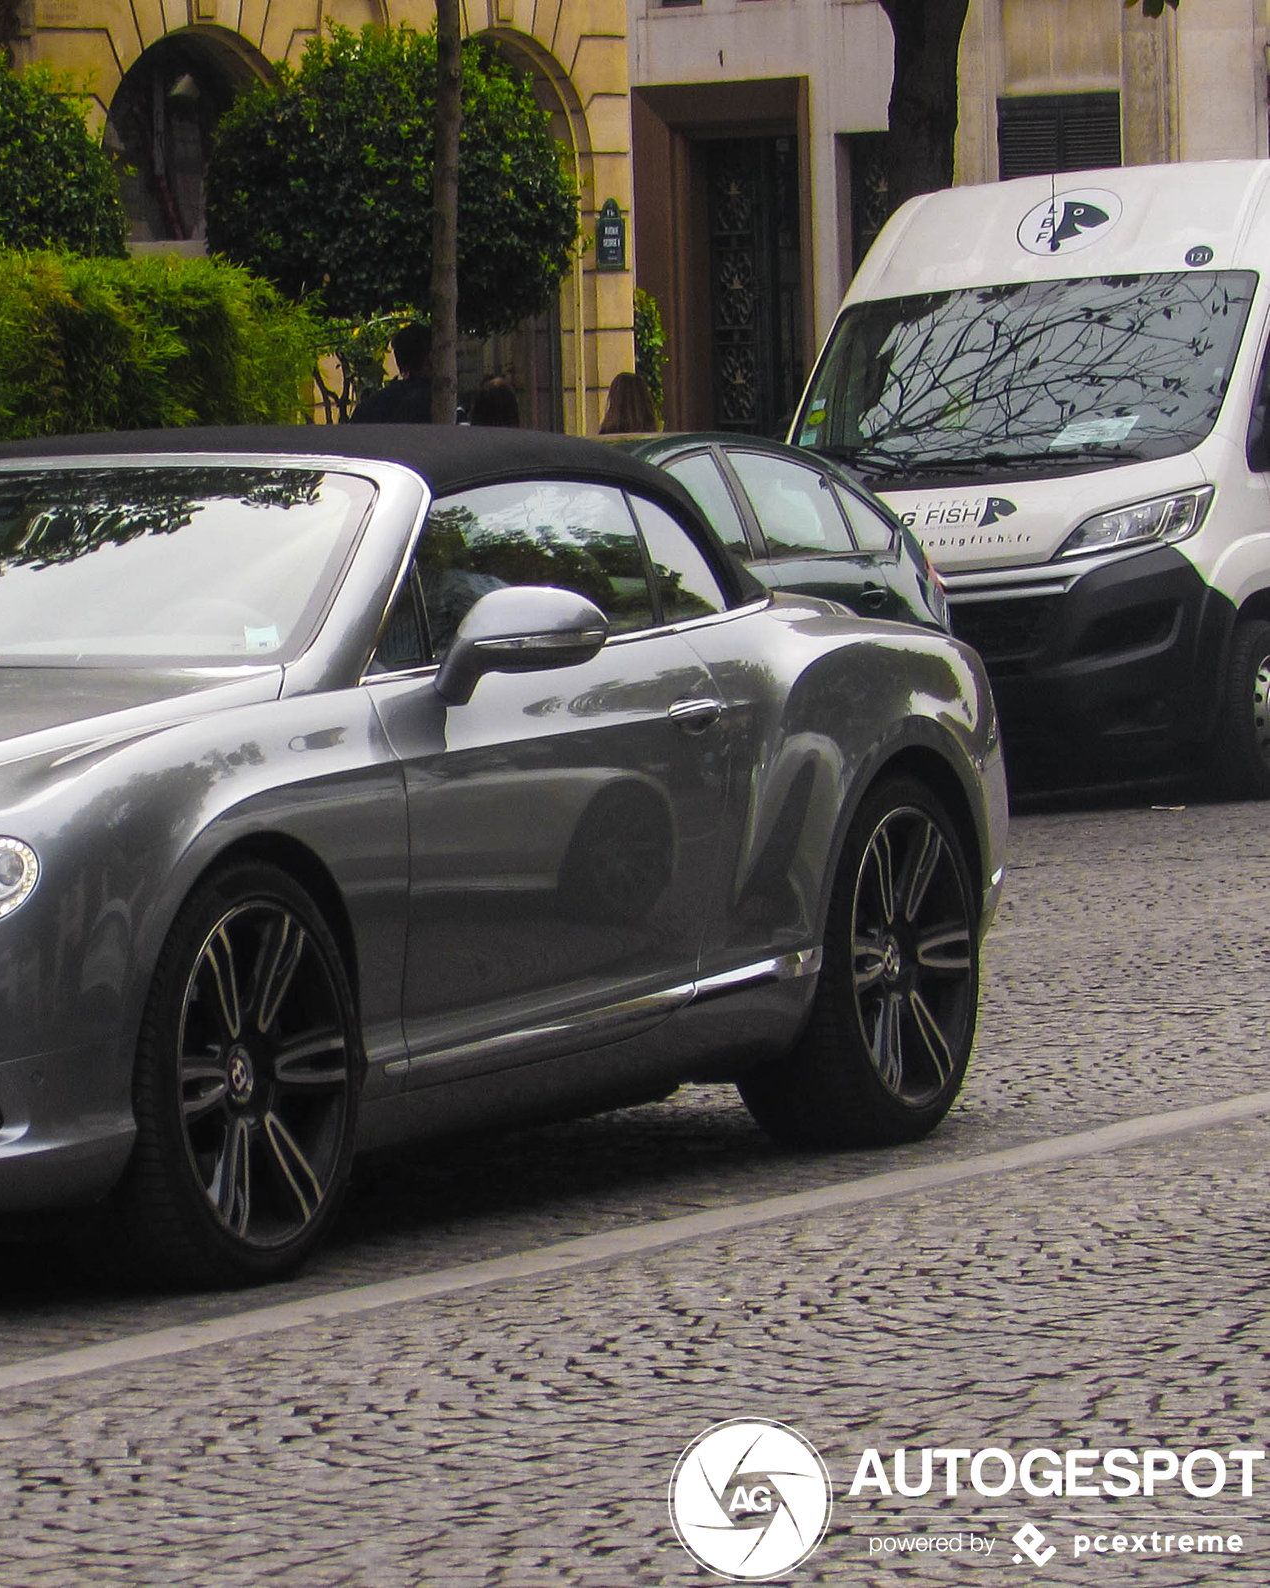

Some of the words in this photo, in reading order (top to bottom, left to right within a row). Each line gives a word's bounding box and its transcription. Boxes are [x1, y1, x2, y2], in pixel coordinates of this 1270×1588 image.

[1040, 218, 1053, 229] B
[1035, 232, 1048, 243] F
[1189, 251, 1209, 262] 121
[915, 498, 985, 511] LITTLE
[925, 507, 981, 525] FISH
[920, 533, 1032, 547] lebigfish.fr
